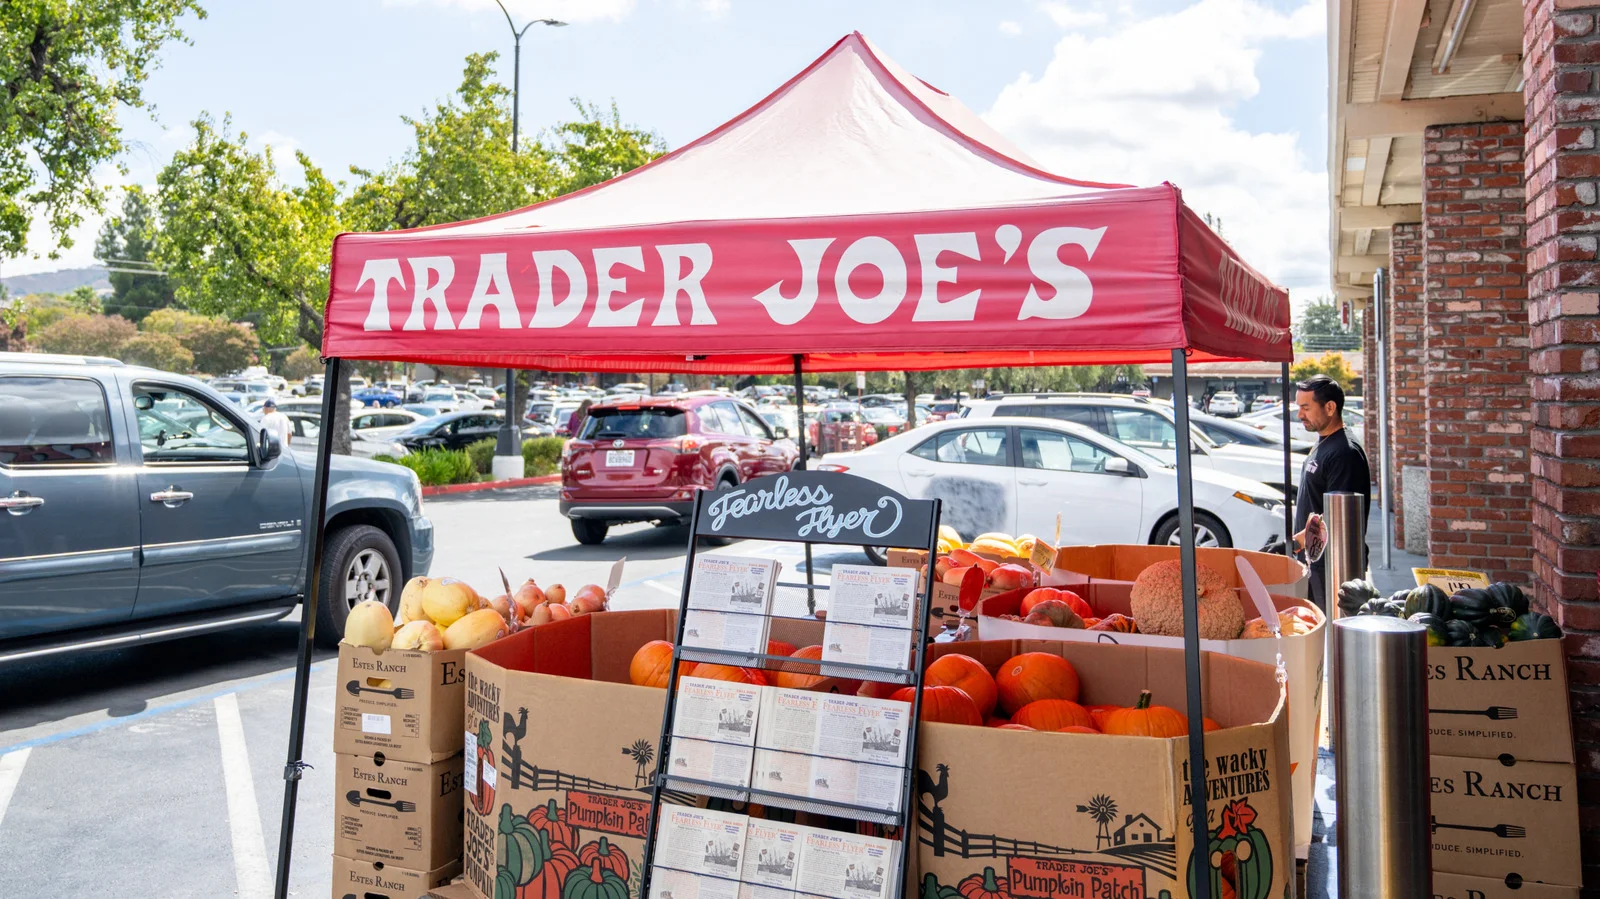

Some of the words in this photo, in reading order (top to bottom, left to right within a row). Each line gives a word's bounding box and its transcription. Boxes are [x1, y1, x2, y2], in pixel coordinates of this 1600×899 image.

[355, 243, 718, 331] TRADER
[752, 224, 1108, 325] JOE'S
[708, 475, 833, 532] Fearless
[796, 495, 903, 539] Flyer
[352, 657, 374, 671] ESTES
[376, 660, 406, 673] RANCH
[1454, 656, 1552, 681] RANCH
[479, 681, 501, 701] wacky
[467, 690, 500, 723] ADVENTURES
[1429, 729, 1455, 737] DUCE.
[1458, 730, 1516, 739] SIMPLIFIED.
[353, 767, 375, 781] ESTES
[377, 772, 407, 786] RANCH
[1182, 758, 1210, 782] te
[1216, 748, 1267, 775] wacky
[1183, 770, 1270, 806] AVENTURES
[1463, 770, 1562, 801] RANCH
[588, 795, 618, 808] TRADER
[466, 807, 495, 846] TRADER
[569, 801, 623, 830] Pumpkin
[629, 816, 650, 835] Pat
[671, 814, 702, 826] FEARLESS
[703, 820, 721, 830] FLYER
[806, 836, 840, 848] FEARLESS
[842, 842, 864, 854] FLYER
[1466, 846, 1524, 858] SIMPLIFIED.
[350, 870, 373, 885] ESTES
[375, 875, 405, 891] RANCH
[465, 855, 494, 899] PUMPKIN
[1036, 861, 1076, 873] TRADER
[1012, 869, 1084, 898] Pumpkin
[1091, 877, 1139, 899] Patch
